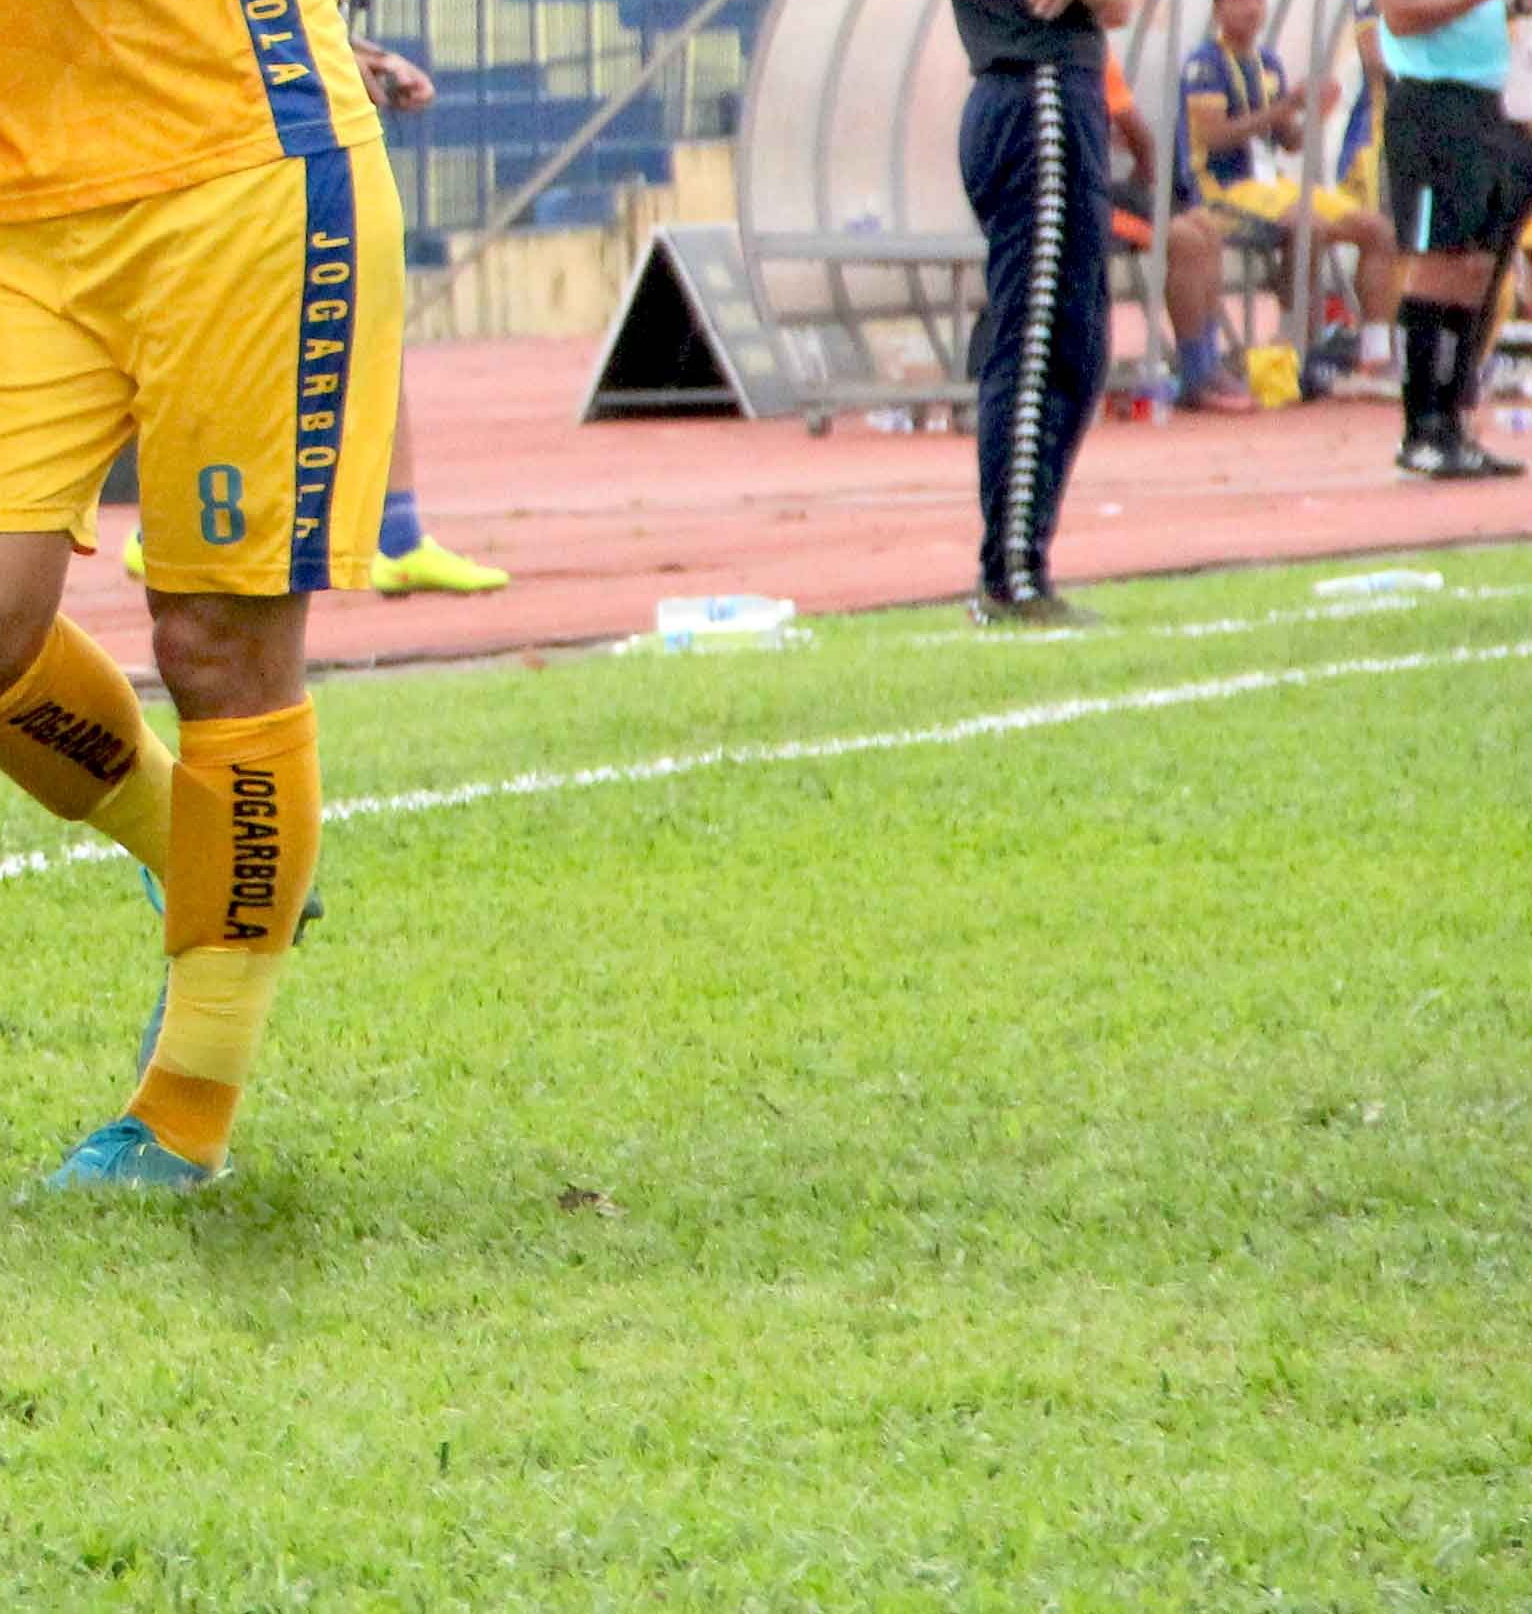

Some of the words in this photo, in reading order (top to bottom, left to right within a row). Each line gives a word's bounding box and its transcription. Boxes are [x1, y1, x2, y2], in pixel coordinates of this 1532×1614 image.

[296, 232, 351, 539] JOGARBOLA
[197, 463, 246, 545] 8
[223, 763, 281, 941] JOGARBOLA
